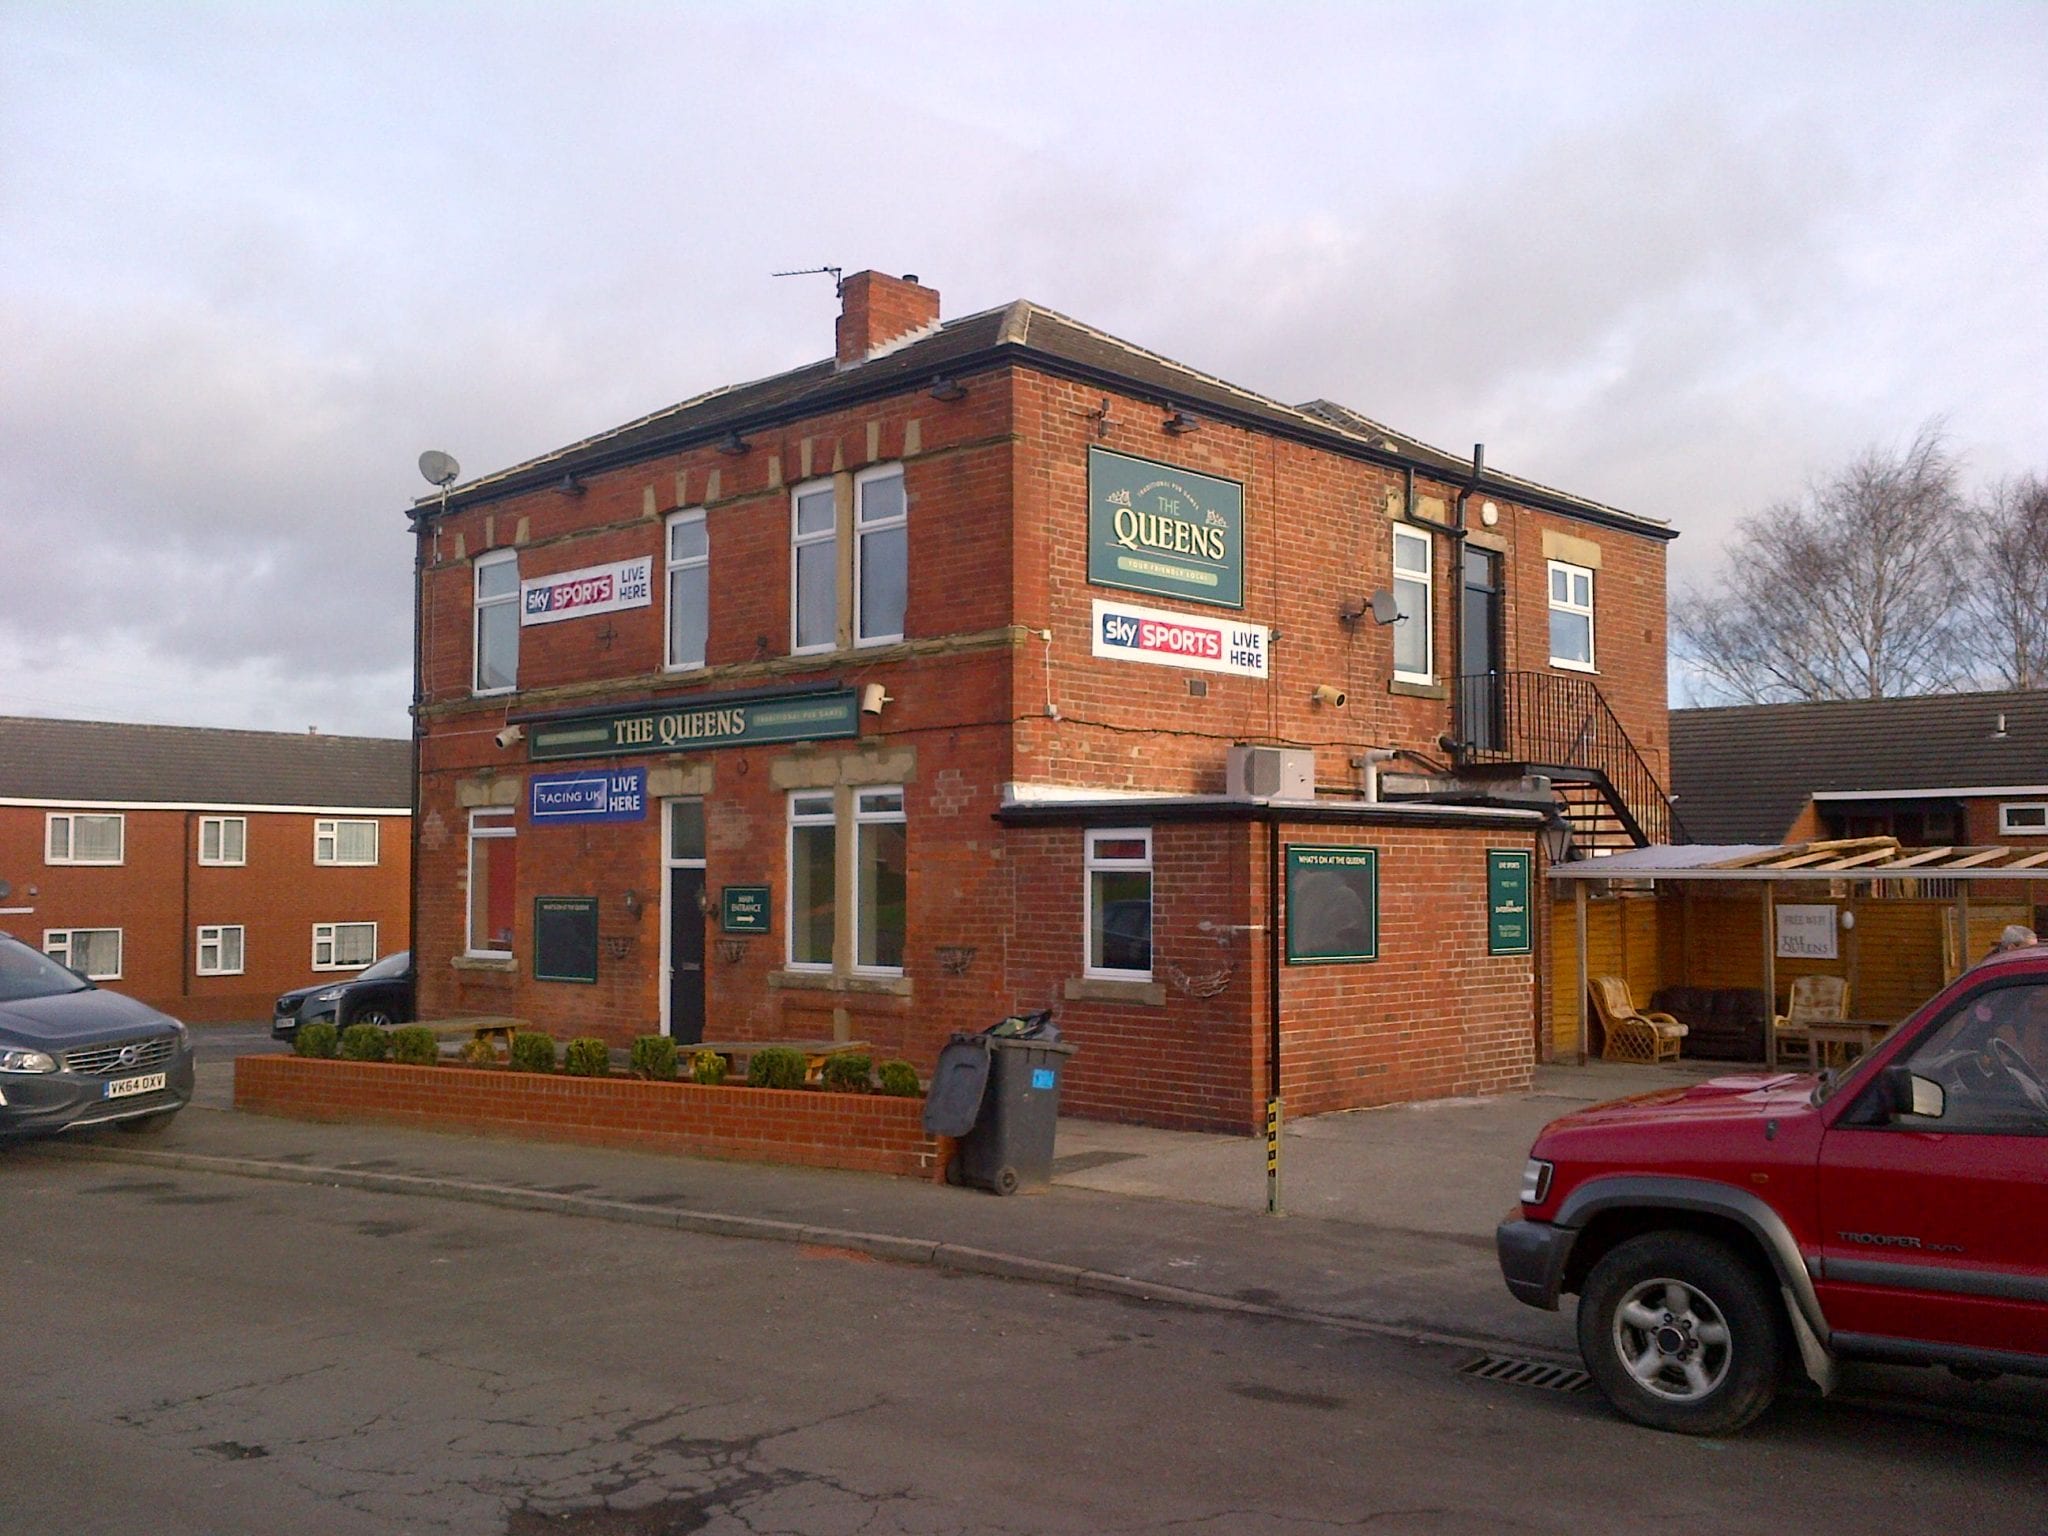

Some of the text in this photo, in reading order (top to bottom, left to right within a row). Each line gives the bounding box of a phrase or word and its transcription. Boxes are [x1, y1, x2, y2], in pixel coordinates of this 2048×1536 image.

[1158, 496, 1181, 516] THE
[1113, 507, 1226, 561] QUEENS
[621, 566, 645, 583] LIVE
[528, 578, 611, 611] sky SPORTS
[619, 584, 647, 601] HERE
[1106, 616, 1219, 655] sky SPORTS
[1232, 630, 1260, 649] LIVE
[1230, 650, 1262, 669] HERE
[614, 717, 654, 745] THE
[658, 708, 747, 745] QUEENS
[611, 775, 638, 792] LIVE
[539, 790, 601, 804] RACING UK
[609, 795, 640, 812] HERE
[731, 903, 761, 912] ENTRANCE
[1782, 935, 1804, 945] THE
[1782, 943, 1828, 954] QUEENS
[111, 1079, 139, 1095] VK64
[1838, 1231, 1922, 1249] TROOPER
